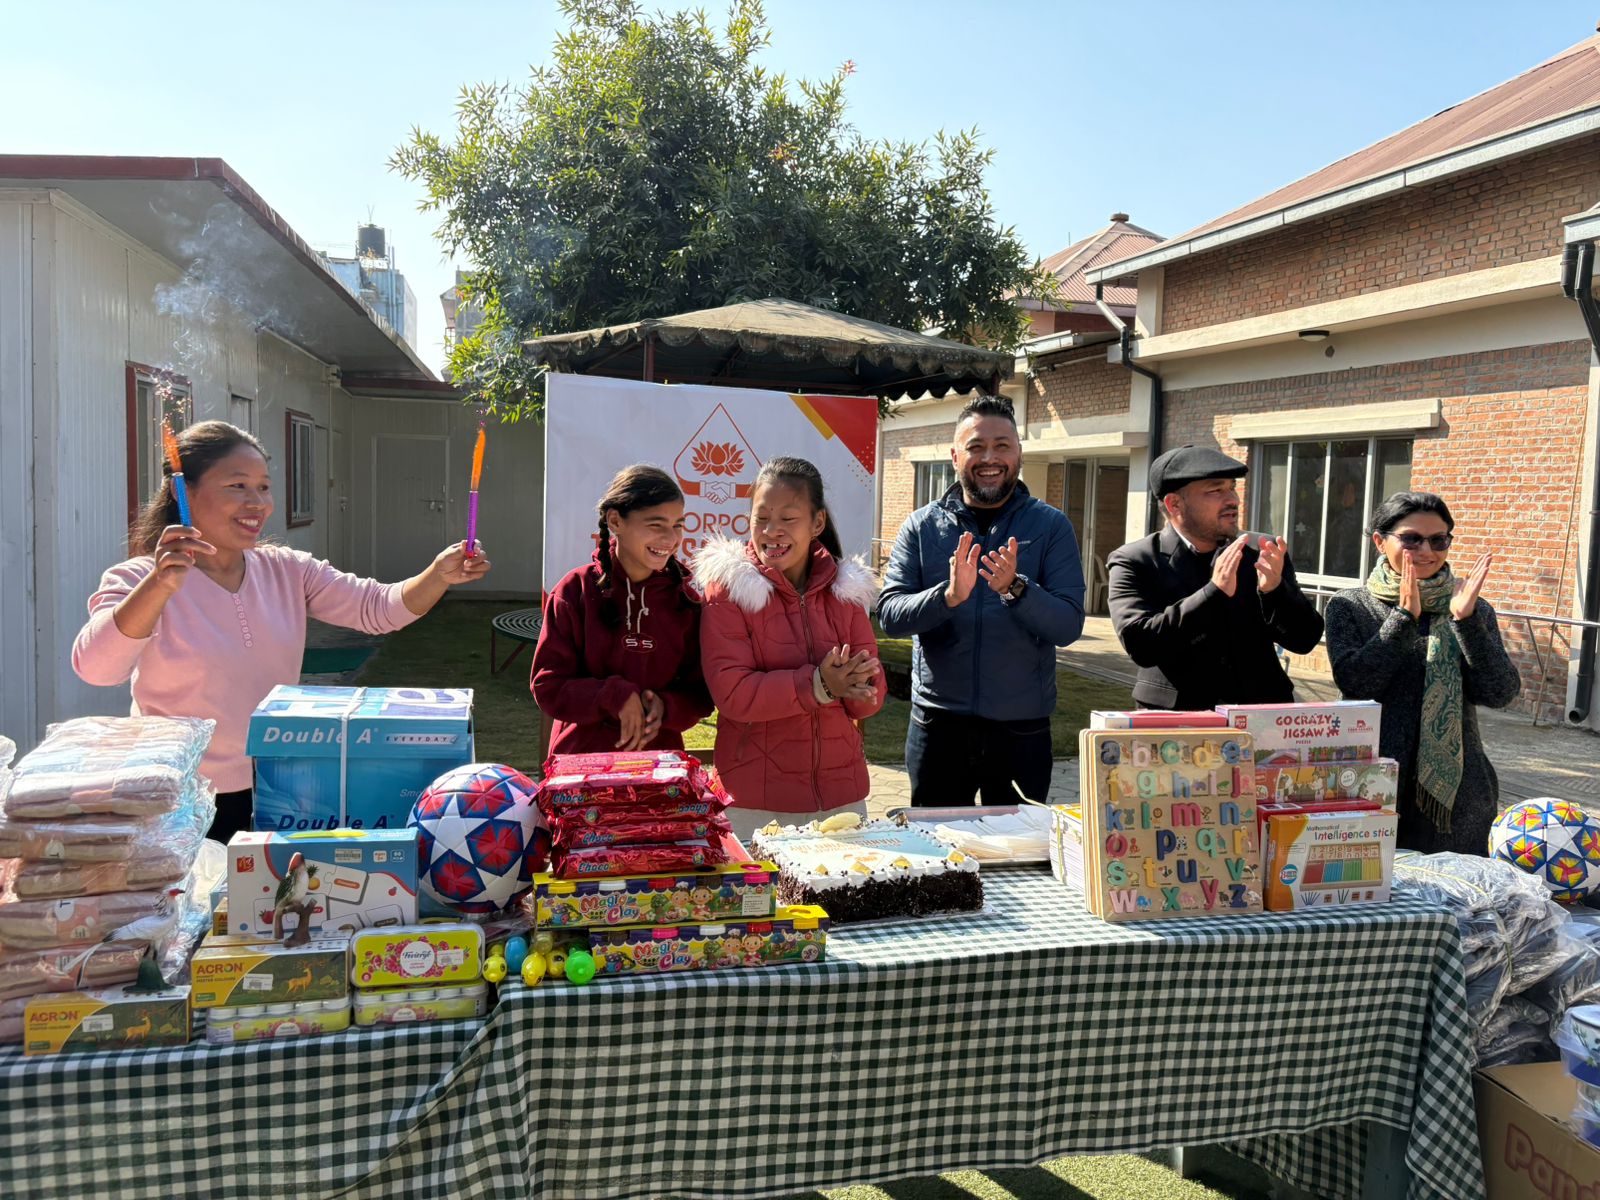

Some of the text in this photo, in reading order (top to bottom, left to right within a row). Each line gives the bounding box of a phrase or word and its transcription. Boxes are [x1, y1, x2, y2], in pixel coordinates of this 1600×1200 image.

[1275, 713, 1332, 726] GO CRAZY
[386, 735, 449, 743] EVERYDAY
[1283, 728, 1324, 739] JIGSAW
[1101, 740, 1121, 765] a
[1130, 739, 1151, 768] b
[1192, 738, 1213, 769] d
[1221, 739, 1241, 765] e
[1137, 769, 1156, 799] g
[1172, 770, 1191, 799] h
[1105, 801, 1124, 832] k
[1171, 802, 1203, 827] m
[1219, 801, 1240, 826] n
[1307, 824, 1340, 832] Mathematical
[1314, 827, 1395, 841] Intelligence stick
[1155, 829, 1177, 861] p
[1196, 828, 1217, 858] q
[1232, 828, 1250, 855] r
[1142, 857, 1158, 888] t
[1176, 858, 1197, 884] u
[580, 894, 628, 912] Magic
[1200, 879, 1219, 911] y
[607, 906, 640, 923] Clay
[633, 940, 680, 959] Magic
[196, 963, 244, 975] ACRON
[658, 953, 693, 970] Clay
[30, 1012, 79, 1023] ACRON
